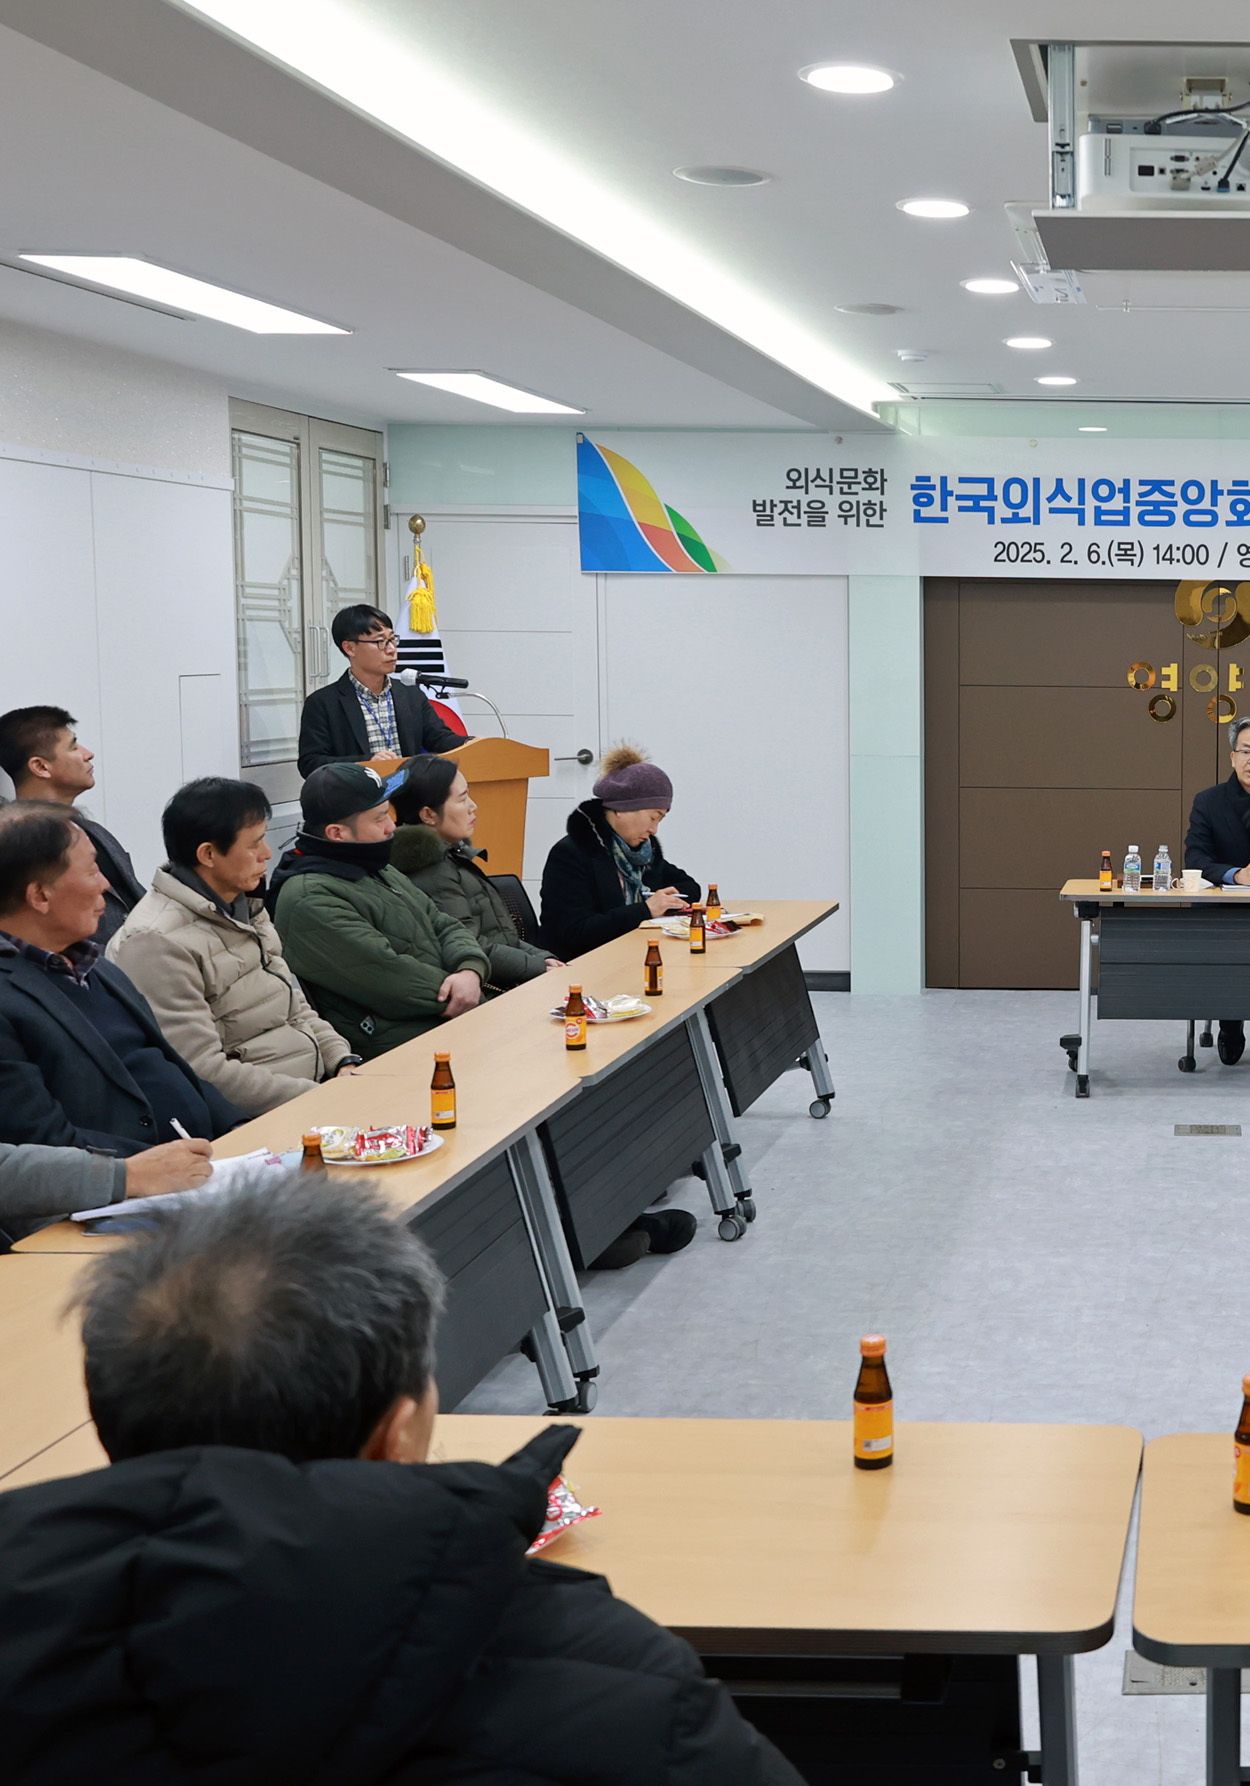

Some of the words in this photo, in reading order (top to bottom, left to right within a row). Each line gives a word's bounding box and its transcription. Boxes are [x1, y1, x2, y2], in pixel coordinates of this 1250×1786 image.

[785, 467, 888, 496] 외식문화
[752, 499, 829, 528] 발전을
[836, 500, 888, 528] 위한
[994, 541, 1050, 564] 2025.
[1060, 542, 1078, 565] 2.
[1088, 540, 1143, 567] 6.(목)
[1153, 544, 1209, 565] 14:00
[1218, 542, 1228, 568] /
